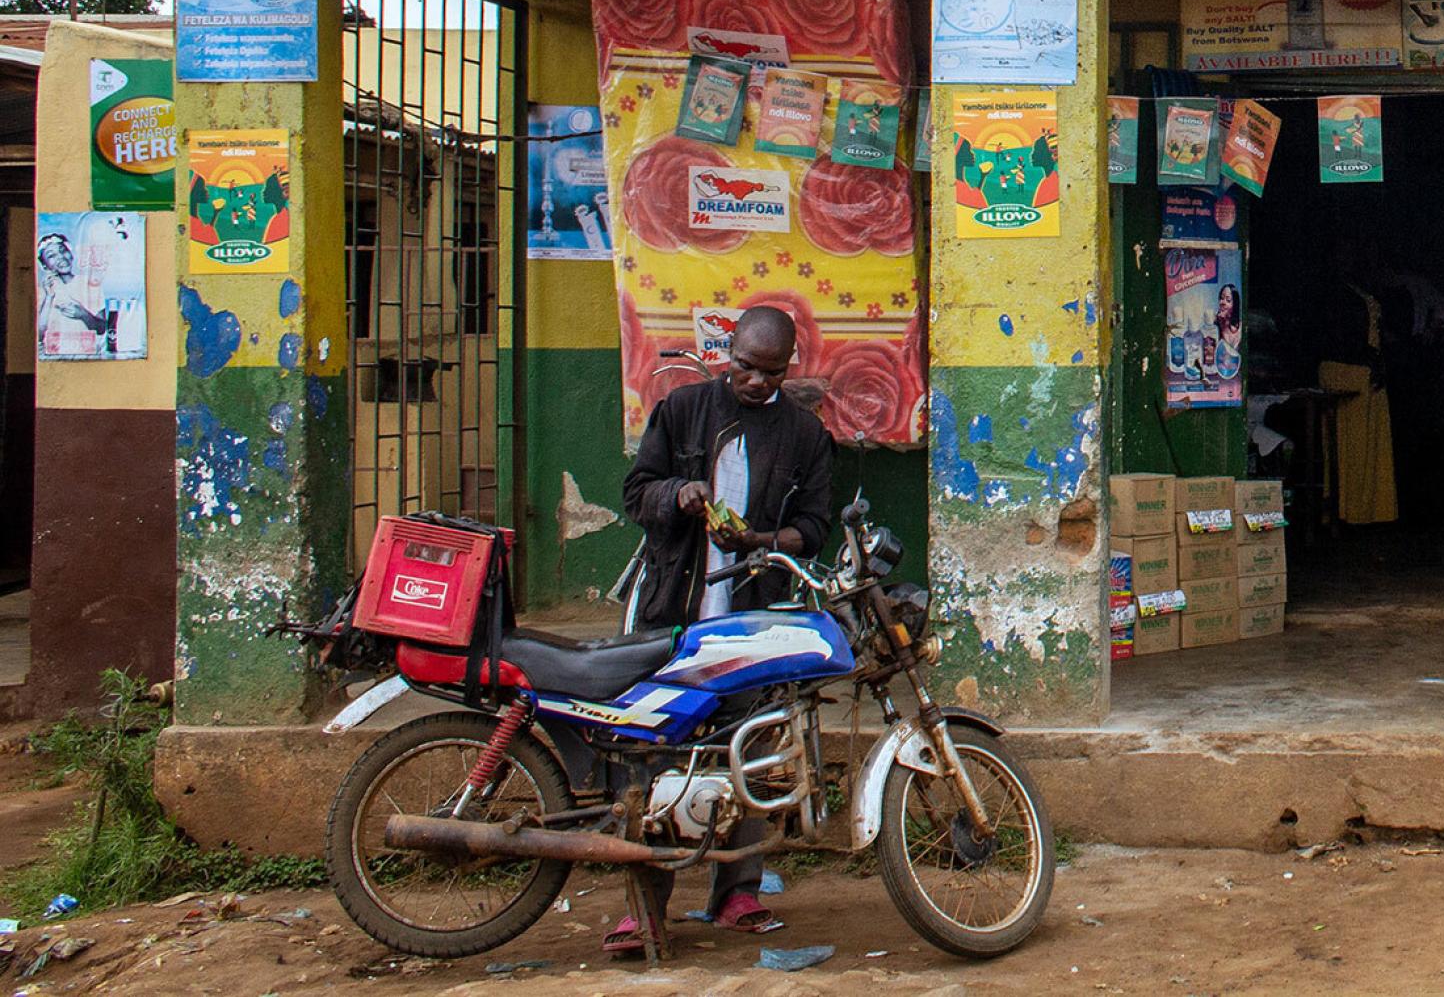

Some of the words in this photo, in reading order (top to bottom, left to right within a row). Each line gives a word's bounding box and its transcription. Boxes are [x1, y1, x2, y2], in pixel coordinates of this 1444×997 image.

[1209, 26, 1245, 34] Quality
[1248, 24, 1275, 32] SALT
[1219, 36, 1269, 44] Botswana
[114, 104, 171, 122] CONNECT
[131, 117, 158, 130] AND
[846, 148, 881, 159] ILLOVO
[1333, 163, 1370, 172] ILLOVO
[697, 201, 784, 216] DREAMFOAM
[982, 211, 1037, 221] ILLOVO
[213, 247, 267, 258] ILLOVO
[1166, 249, 1205, 278] Diva
